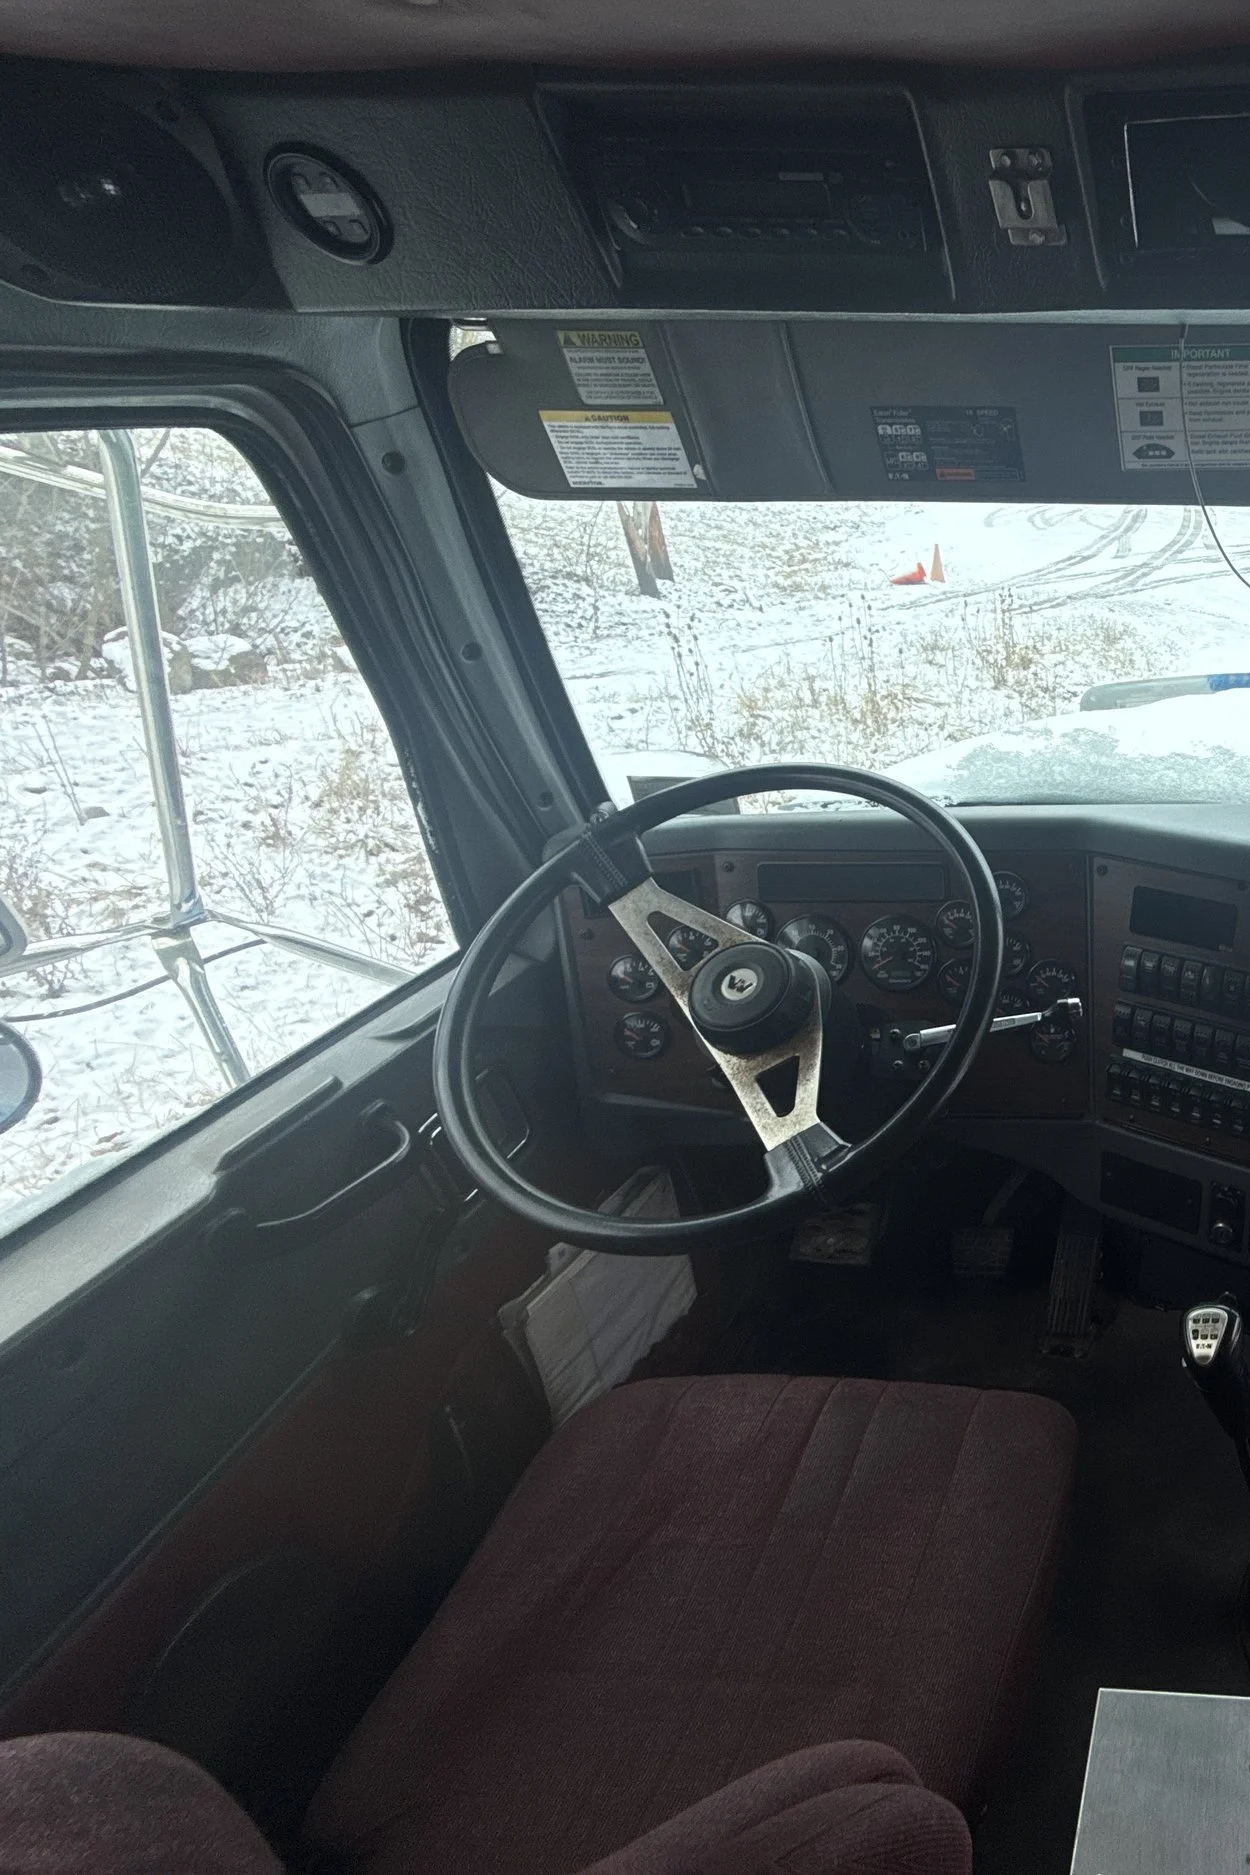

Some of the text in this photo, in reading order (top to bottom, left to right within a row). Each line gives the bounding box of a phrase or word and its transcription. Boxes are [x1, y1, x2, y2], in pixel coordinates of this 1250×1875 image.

[578, 333, 641, 347] WARNING
[1171, 348, 1231, 360] IMPORTANT
[595, 356, 616, 364] MUST
[590, 414, 630, 422] CAUTION
